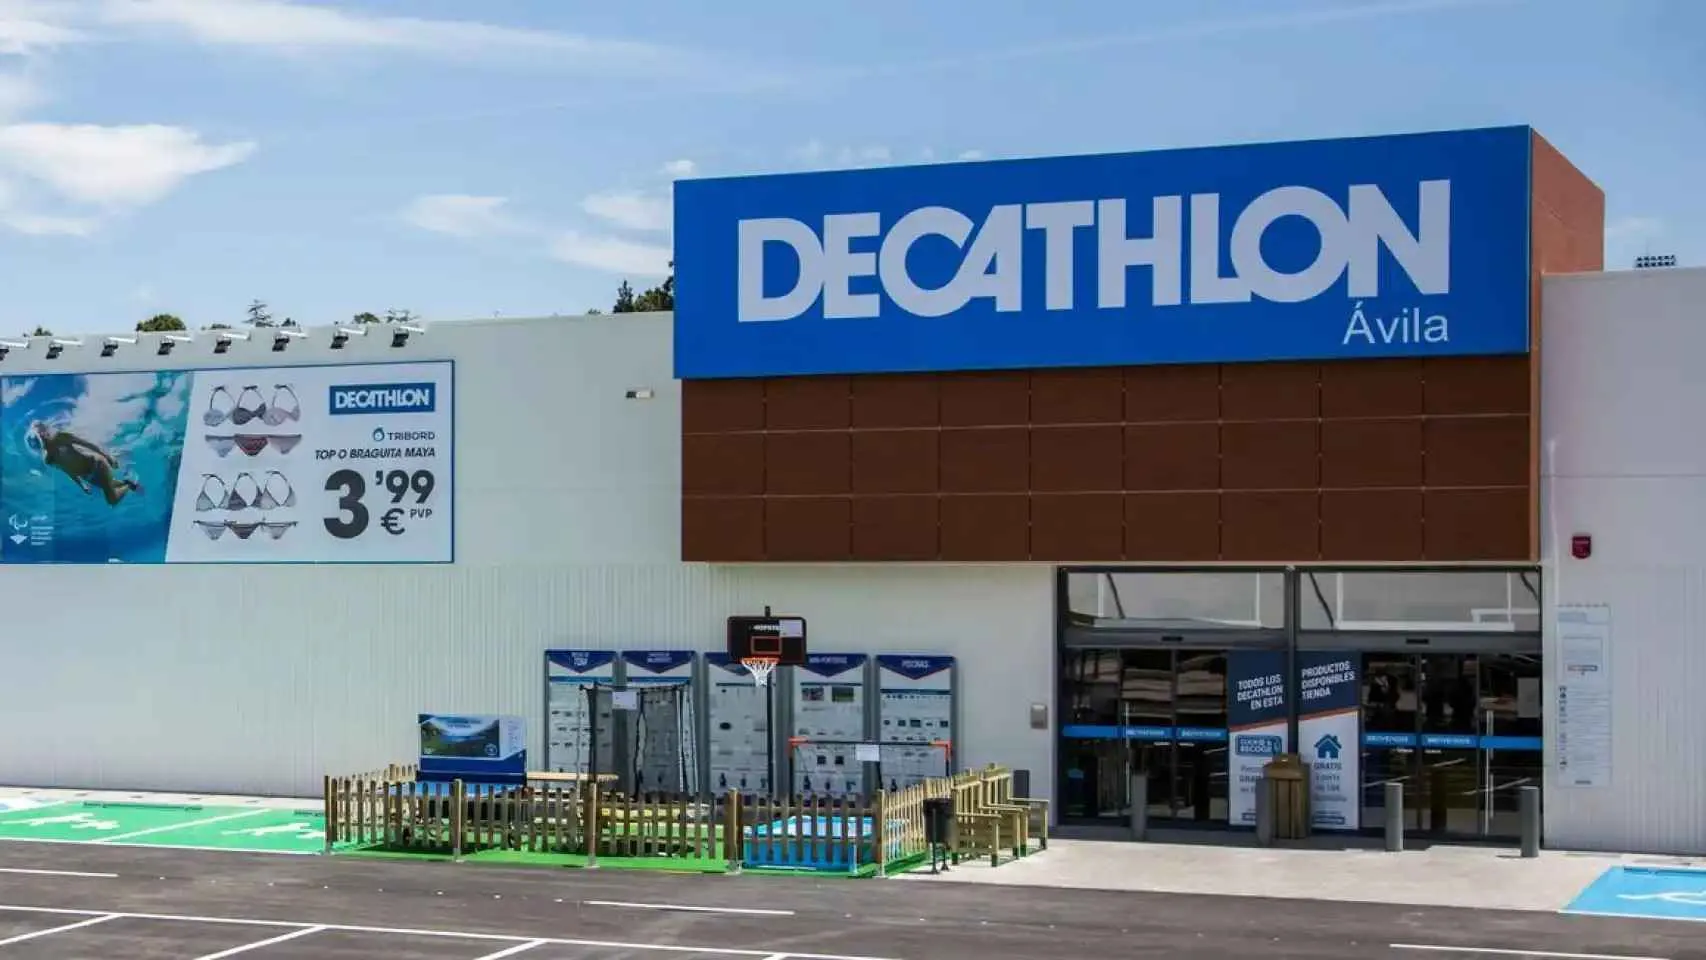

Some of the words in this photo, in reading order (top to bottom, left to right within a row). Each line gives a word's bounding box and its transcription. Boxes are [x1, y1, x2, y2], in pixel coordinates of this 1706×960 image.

[738, 180, 1450, 323] DECATHLON
[1342, 302, 1450, 345] Ávila
[335, 389, 430, 409] DECATHLON
[387, 431, 436, 441] TRIBORD
[315, 449, 336, 460] TOP
[338, 449, 347, 459] O
[349, 447, 402, 459] BRAGUITA
[404, 447, 436, 457] MAYA
[323, 468, 370, 540] 3
[380, 507, 406, 536] €
[409, 508, 433, 519] PVP
[1301, 661, 1351, 679] PRODUCTOS
[1238, 677, 1264, 691] TODOS
[1265, 673, 1282, 686] LOS
[1301, 671, 1356, 690] DISPONIBLES
[1237, 684, 1284, 702] DECATHLON
[1301, 687, 1332, 701] TIENDA
[1250, 700, 1262, 710] EN
[1263, 695, 1284, 708] ESTA
